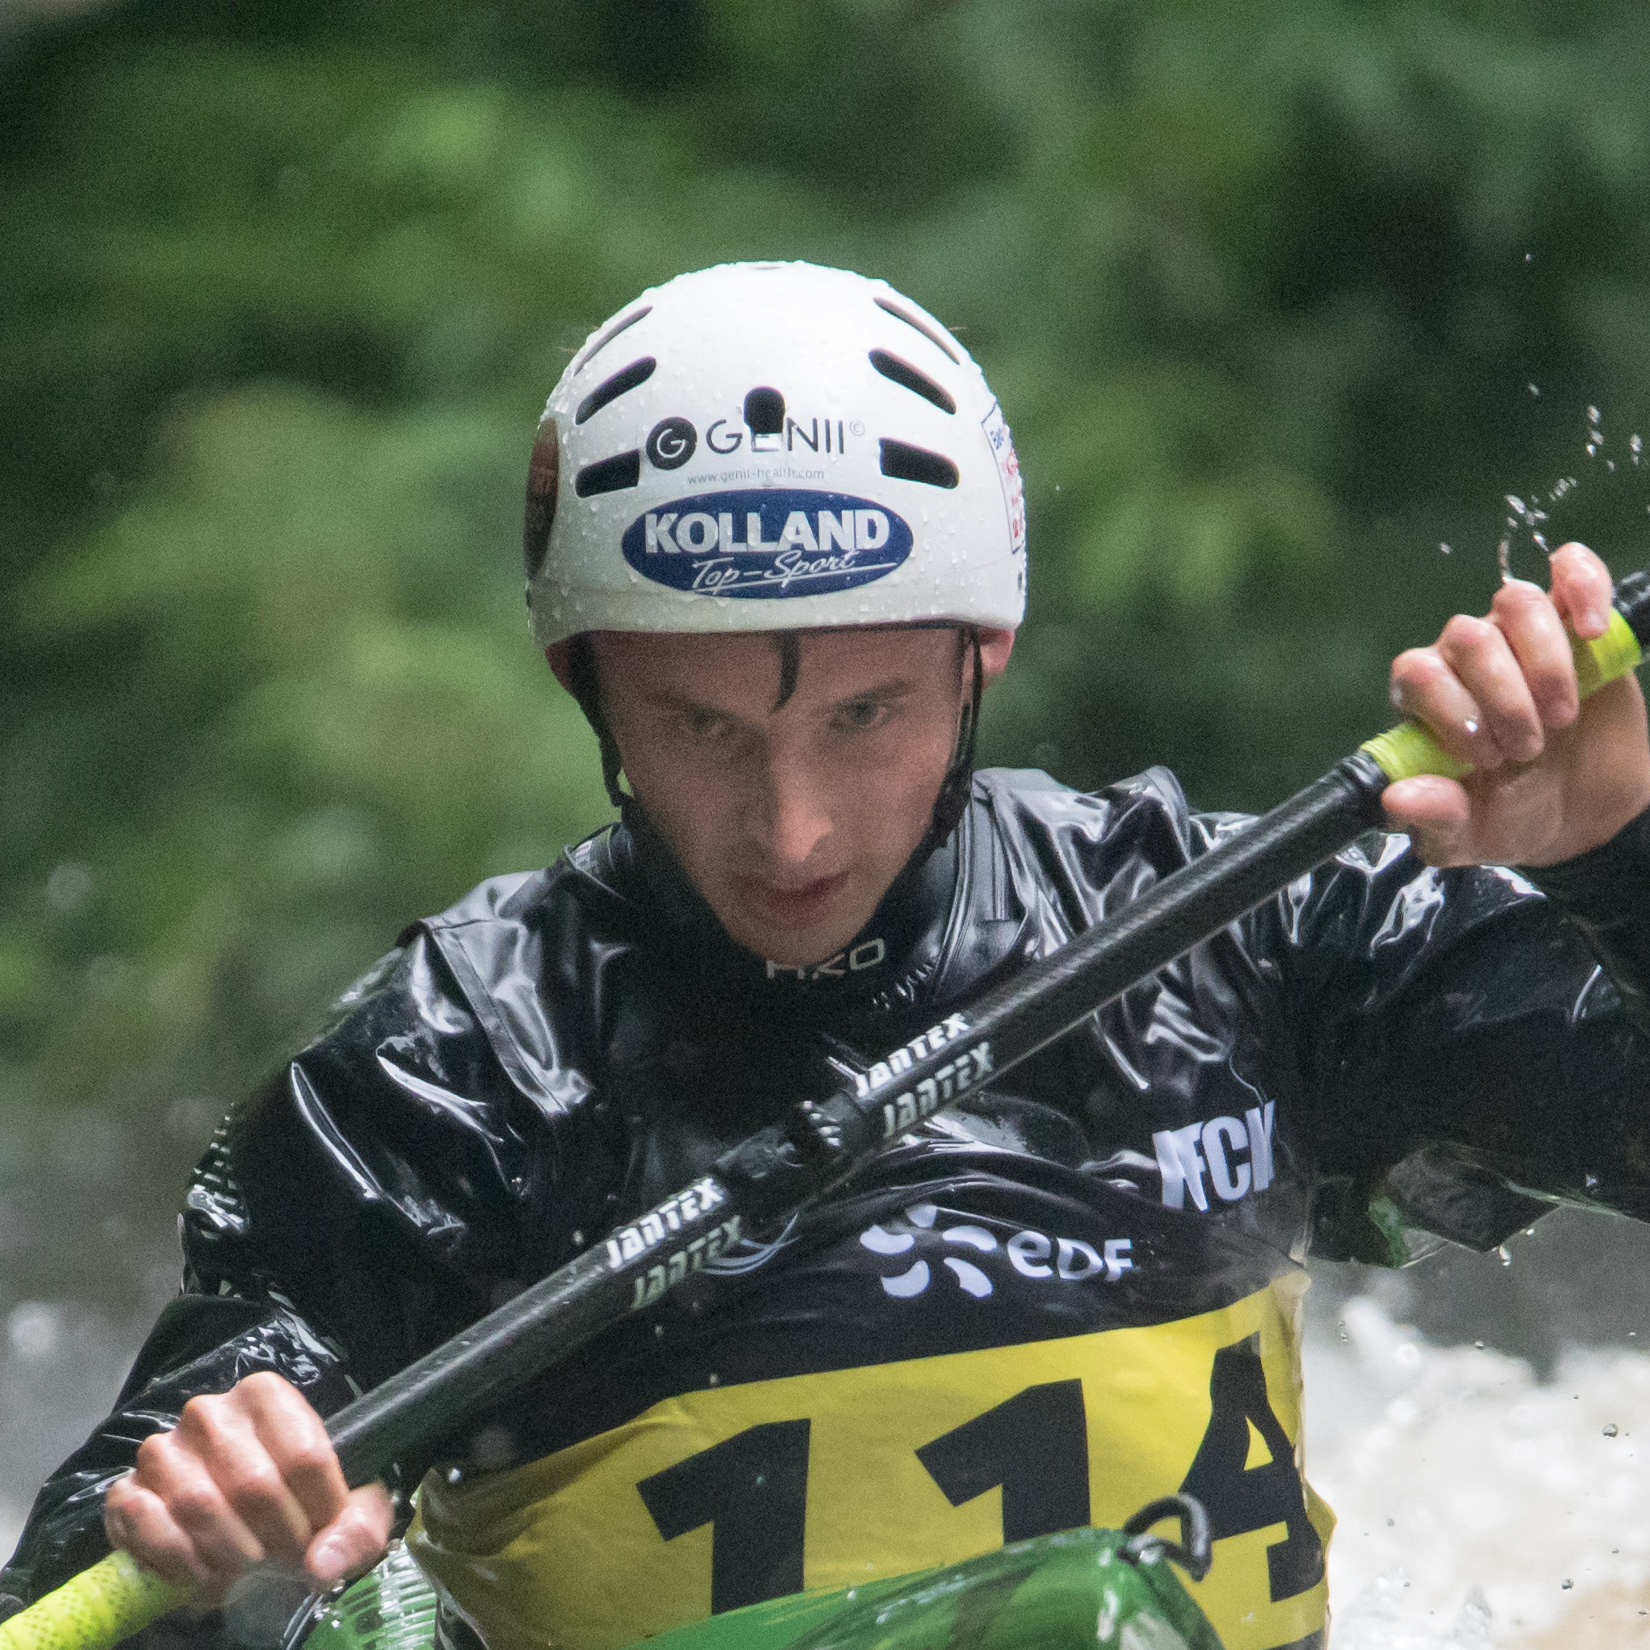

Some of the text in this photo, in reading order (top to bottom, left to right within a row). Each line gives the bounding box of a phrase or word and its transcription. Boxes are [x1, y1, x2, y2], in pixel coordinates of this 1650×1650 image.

[644, 508, 891, 554] KOLLAND
[691, 549, 861, 594] Top-Sport
[635, 1332, 1325, 1615] 114
